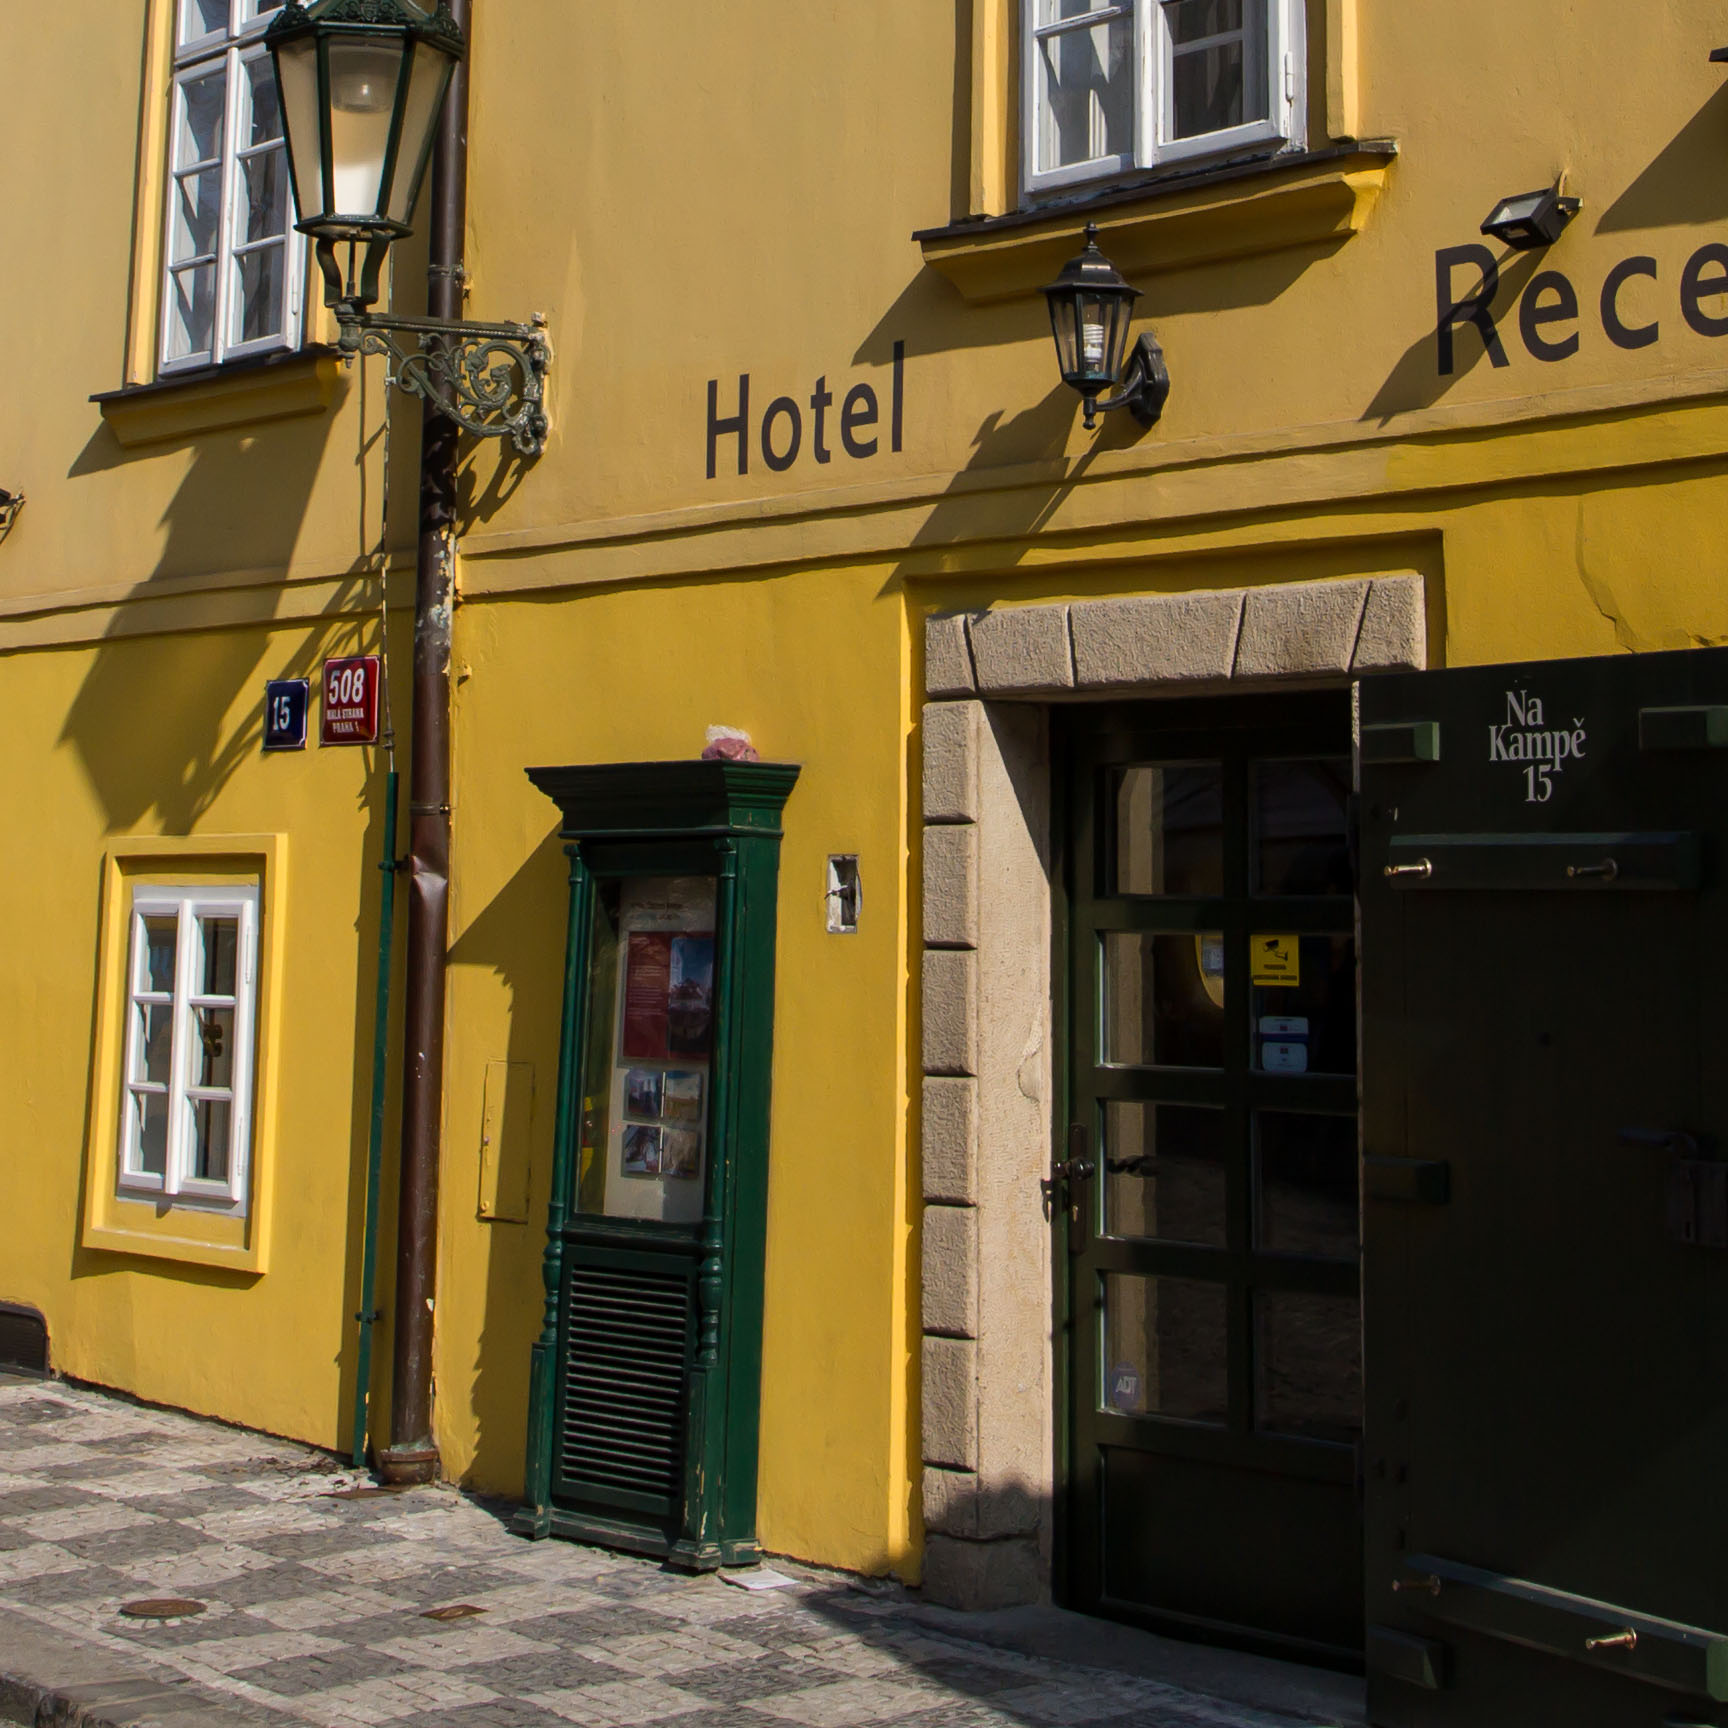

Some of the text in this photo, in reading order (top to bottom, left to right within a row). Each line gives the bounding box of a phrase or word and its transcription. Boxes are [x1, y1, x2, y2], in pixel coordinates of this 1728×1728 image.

[706, 340, 905, 479] Hotel
[329, 668, 365, 705] 508
[273, 696, 291, 731] 15
[1506, 689, 1544, 727] Na
[332, 722, 354, 733] PRAHA
[1488, 717, 1587, 772] Kampě
[1522, 763, 1553, 803] 15
